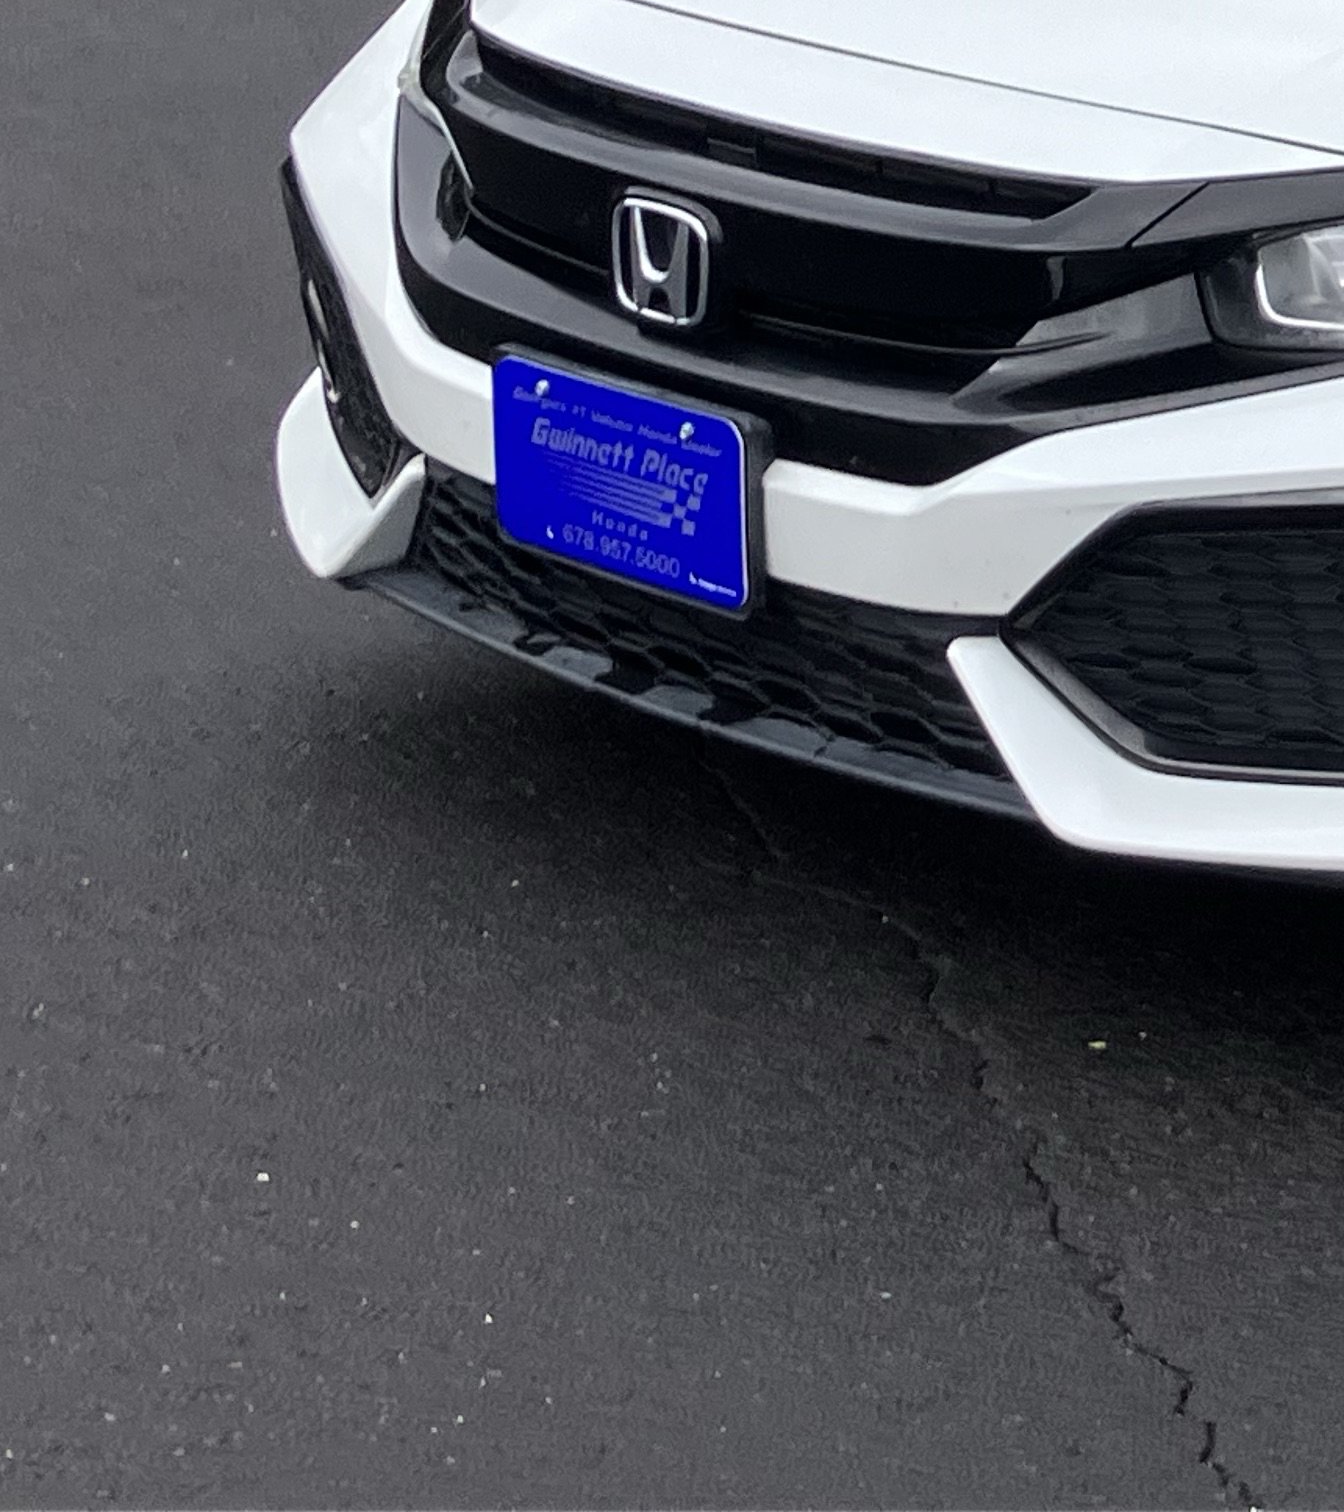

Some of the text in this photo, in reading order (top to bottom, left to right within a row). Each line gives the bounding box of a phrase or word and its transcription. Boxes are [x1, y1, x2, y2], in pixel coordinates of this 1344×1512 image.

[531, 417, 709, 496] Gwinnett Place
[592, 509, 648, 541] Honda
